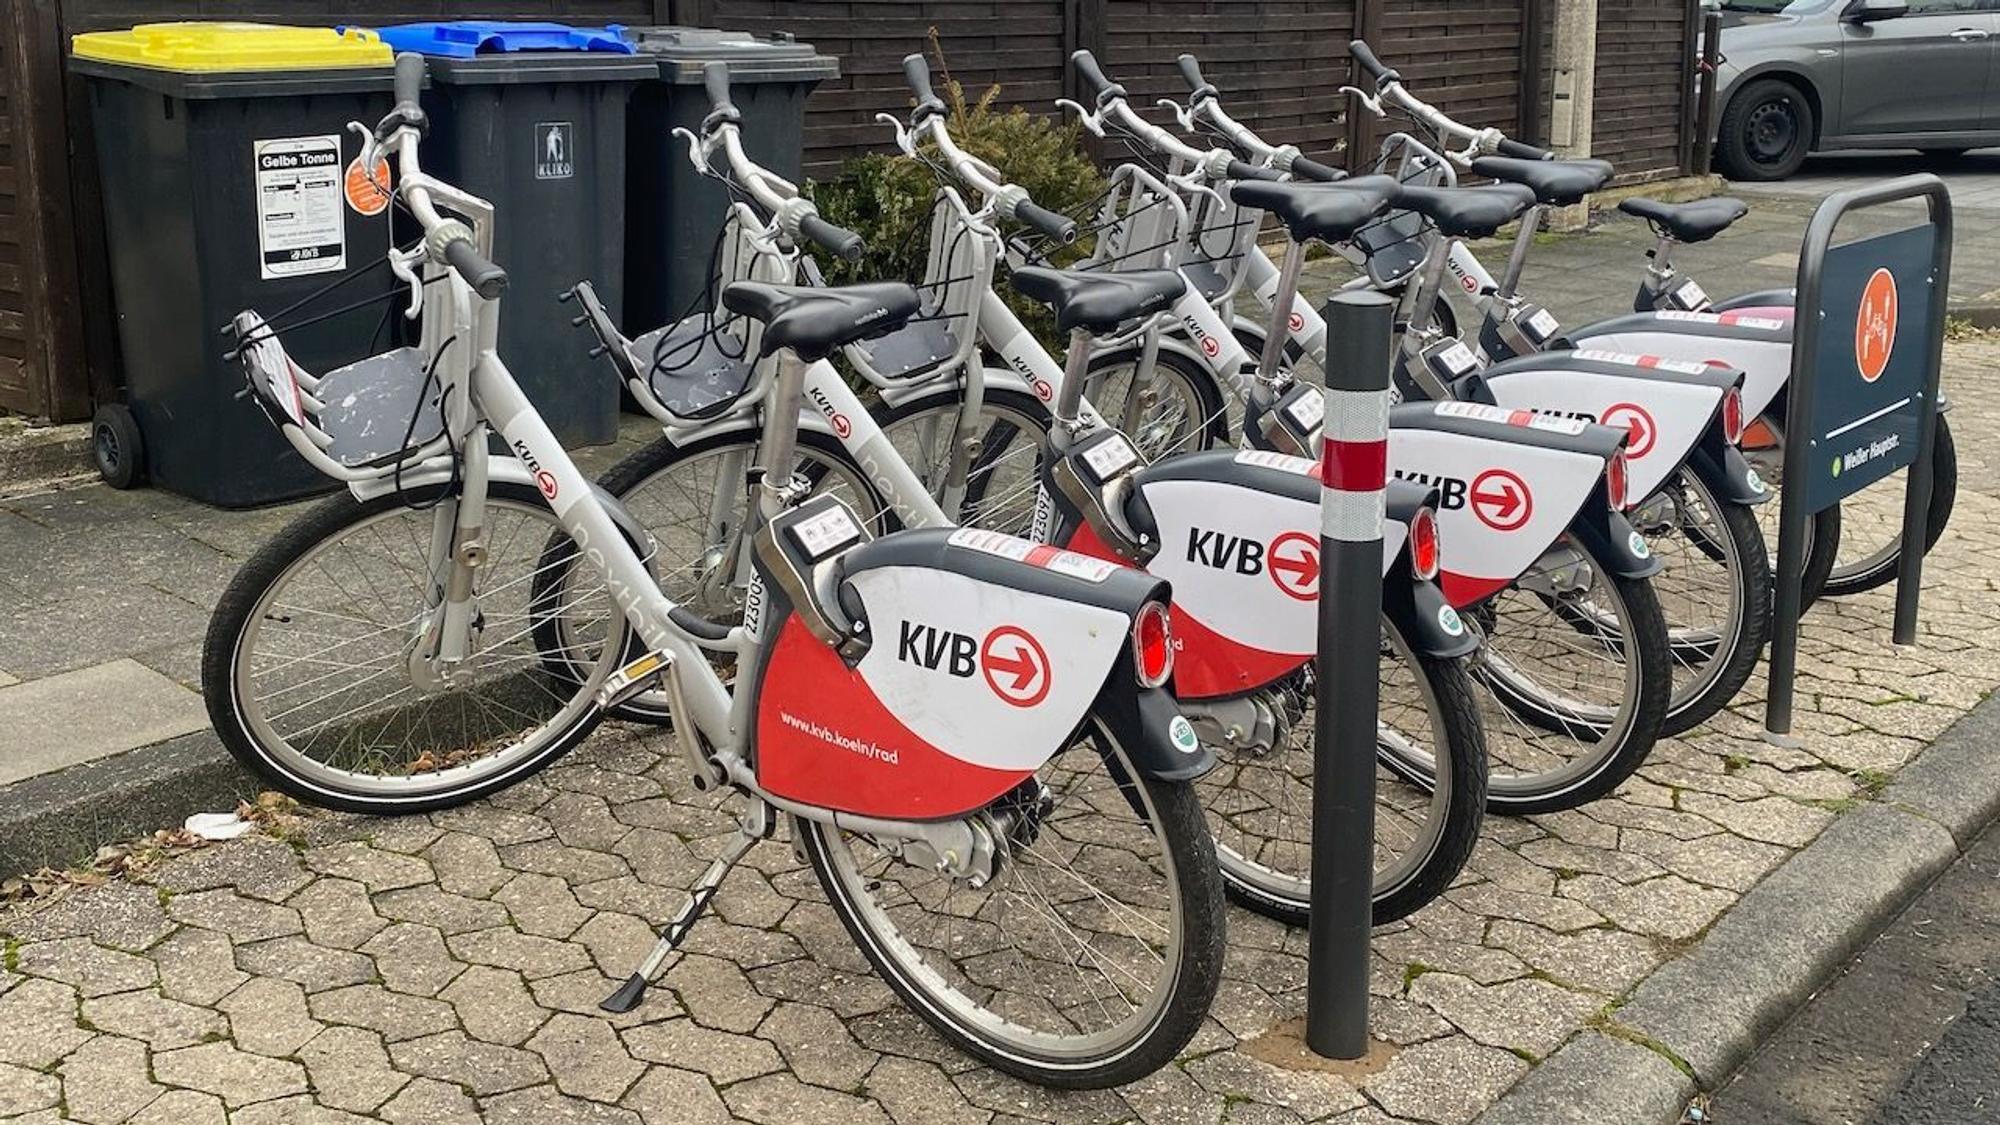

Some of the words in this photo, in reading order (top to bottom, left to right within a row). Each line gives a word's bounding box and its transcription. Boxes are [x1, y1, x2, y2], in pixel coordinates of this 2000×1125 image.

[262, 155, 298, 168] Gelbe
[301, 152, 336, 165] Tonne
[539, 163, 570, 176] KLIKO
[1012, 356, 1038, 383] KVB
[810, 387, 836, 417] KVB
[513, 439, 541, 474] KVB
[1187, 526, 1265, 576] KVB
[745, 571, 764, 634] 223005
[899, 619, 978, 677] KVB
[780, 711, 899, 765] www.kvb.koeln/rad
